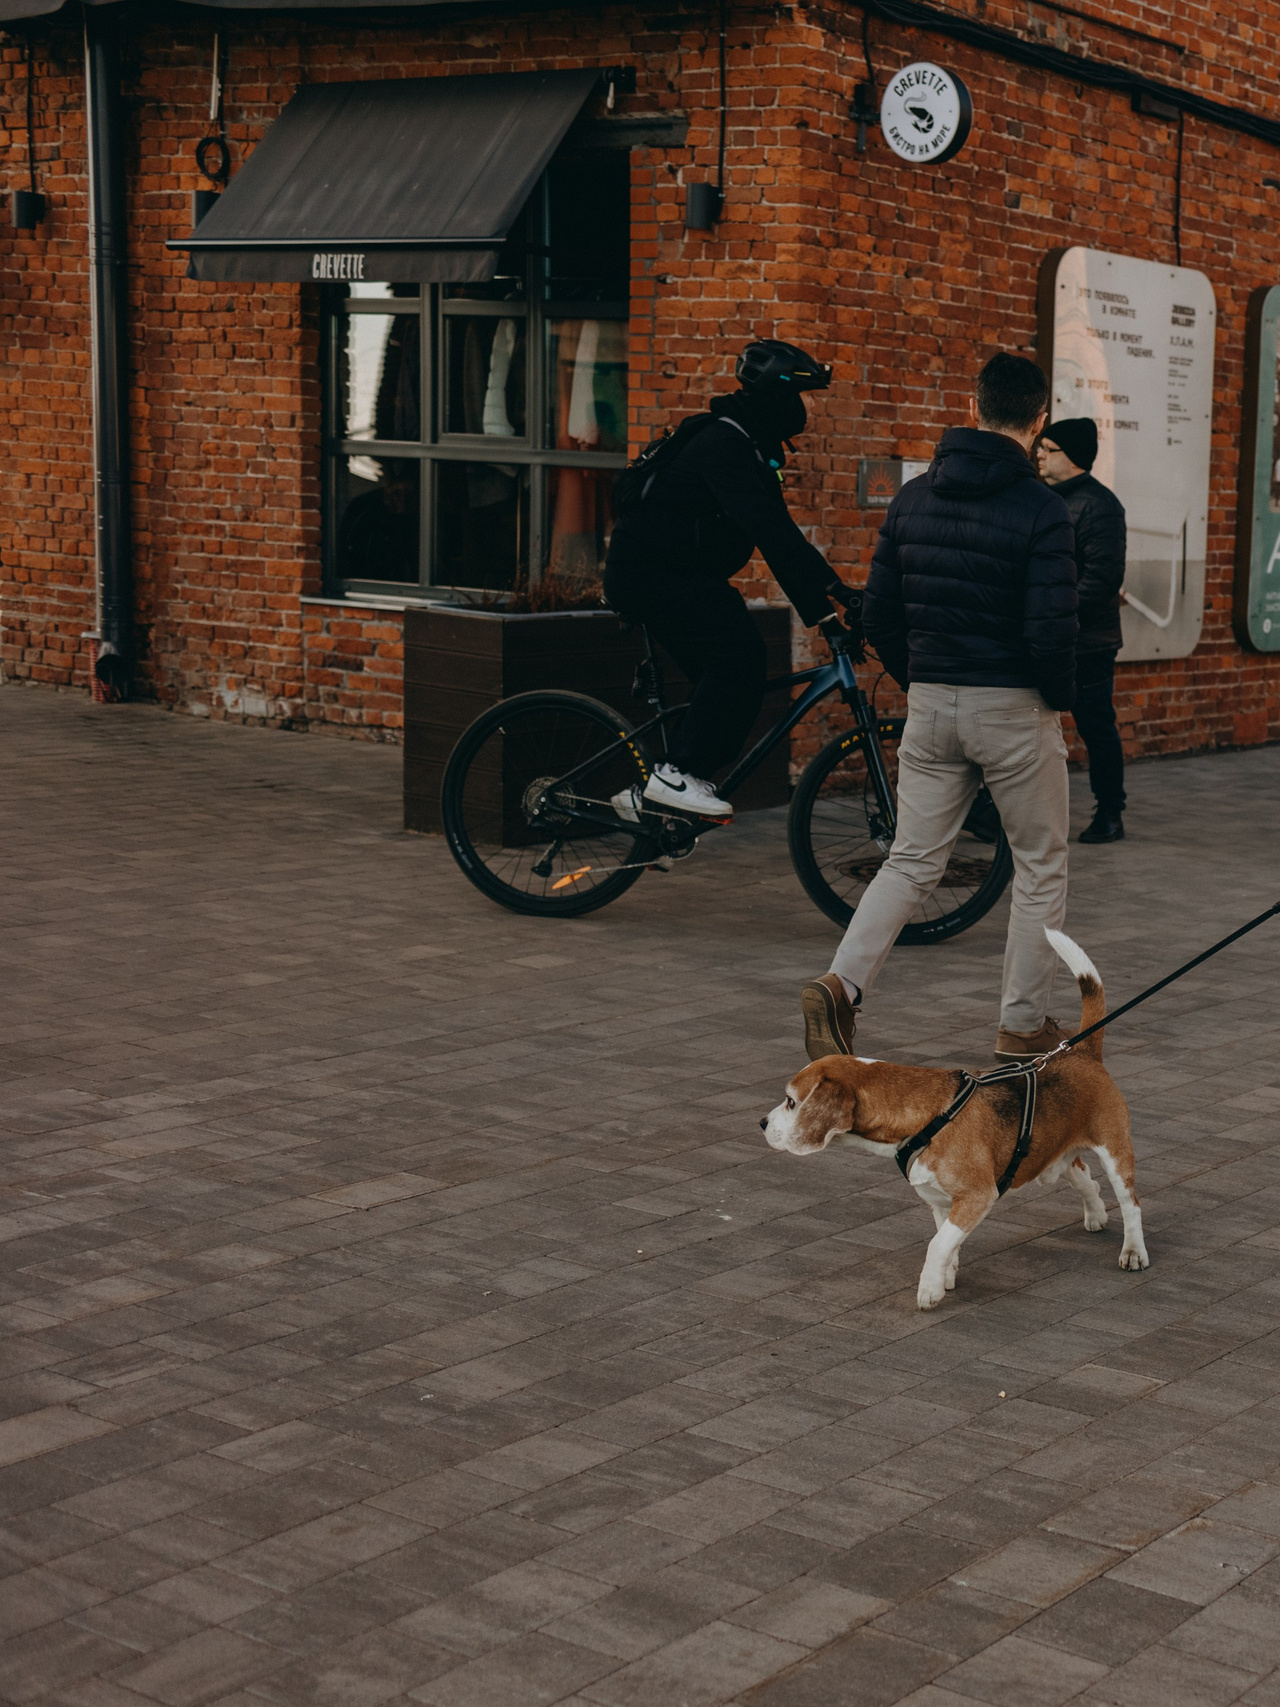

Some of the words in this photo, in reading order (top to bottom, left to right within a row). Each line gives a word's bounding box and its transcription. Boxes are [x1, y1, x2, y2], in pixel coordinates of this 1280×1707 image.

[893, 70, 948, 97] CREVETTE
[889, 126, 916, 155] БИСТРО
[918, 144, 930, 155] НА
[931, 124, 951, 149] МОРЕ
[312, 253, 366, 279] CREVETTE
